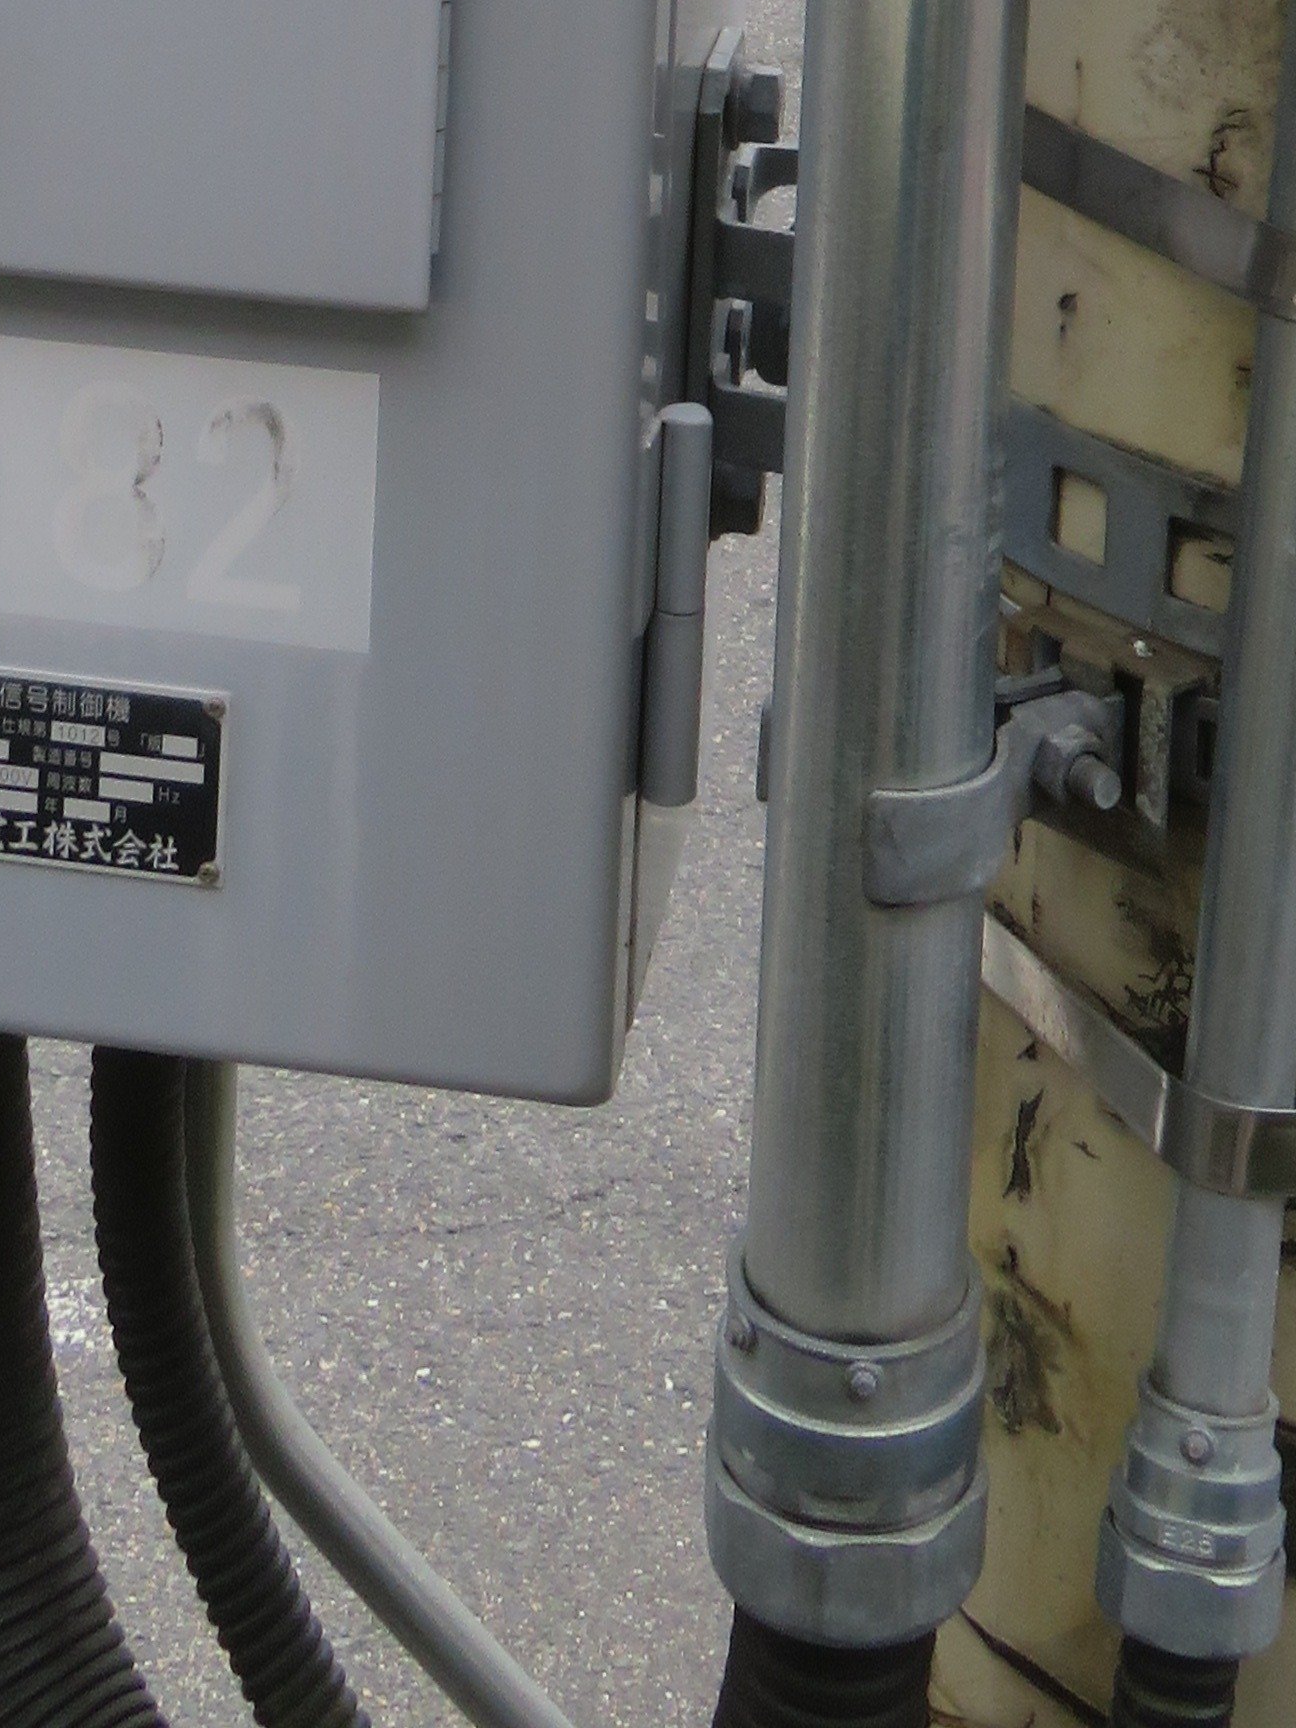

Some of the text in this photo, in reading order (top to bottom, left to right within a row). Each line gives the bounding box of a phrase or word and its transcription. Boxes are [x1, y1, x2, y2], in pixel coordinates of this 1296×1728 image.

[58, 724, 101, 744] 1012
[158, 785, 181, 805] Hz
[44, 796, 59, 815] 年
[114, 805, 128, 824] 月
